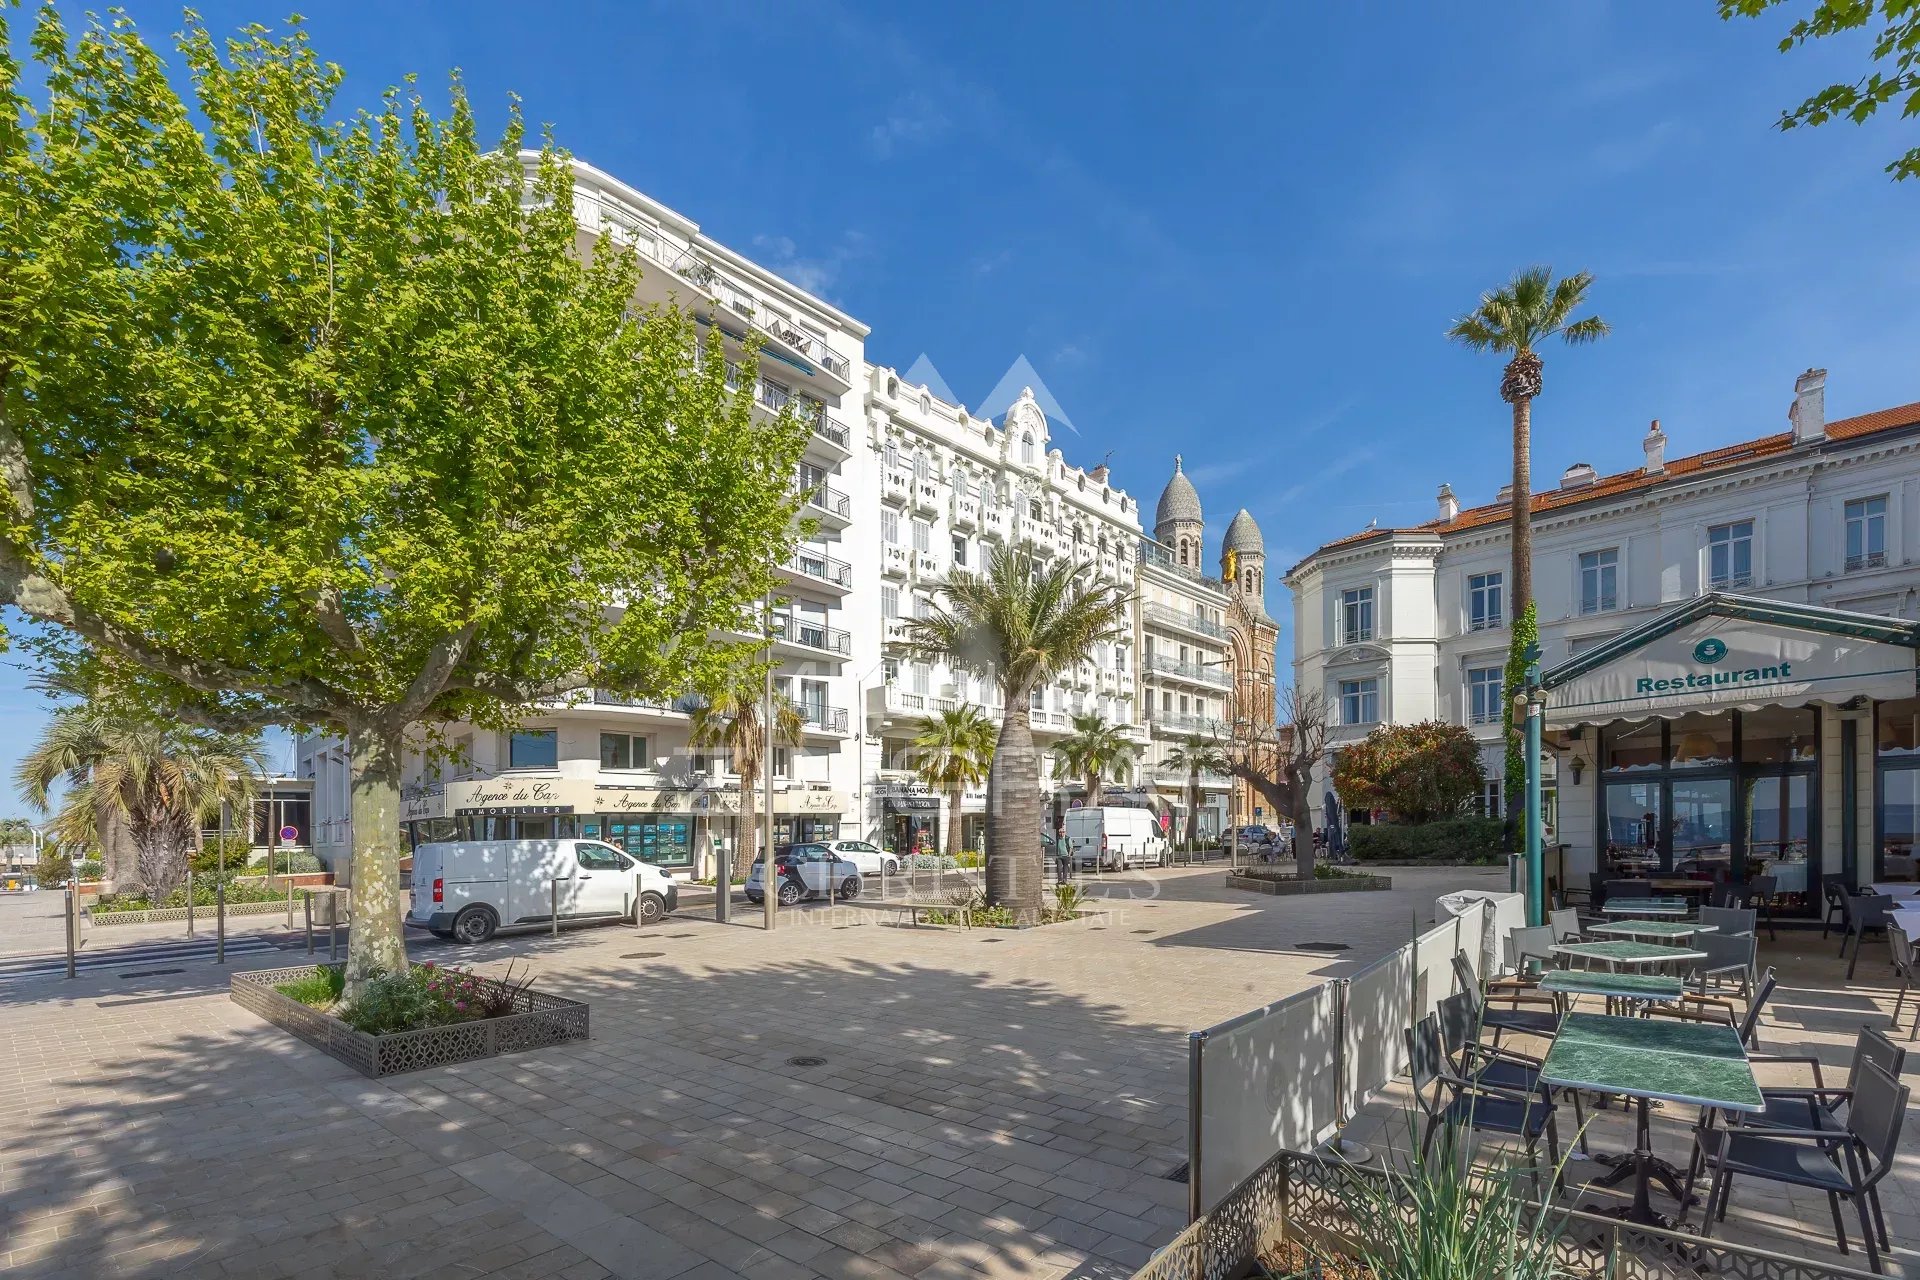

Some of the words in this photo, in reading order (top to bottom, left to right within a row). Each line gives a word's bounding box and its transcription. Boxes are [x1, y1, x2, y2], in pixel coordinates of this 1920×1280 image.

[1636, 661, 1791, 693] Restaurant
[466, 785, 508, 806] Agence
[513, 788, 529, 801] du
[533, 783, 559, 803] Cap
[613, 793, 648, 811] Agence
[651, 797, 662, 807] du
[462, 806, 560, 816] IMMOBILIER
